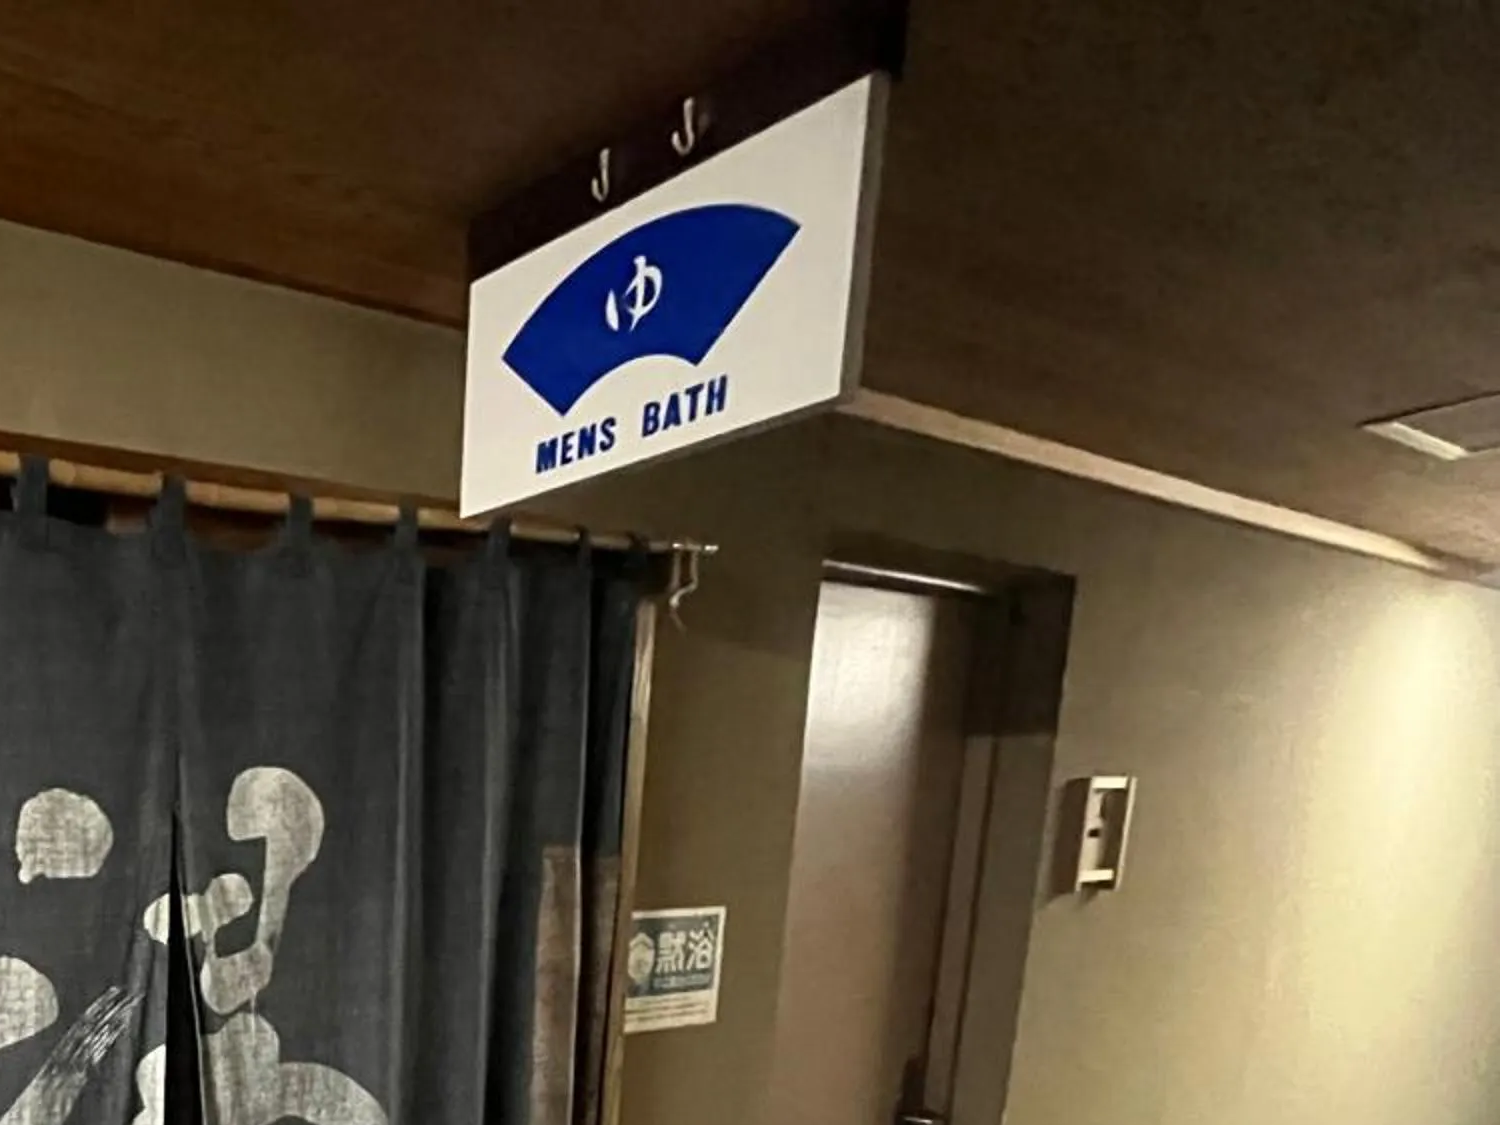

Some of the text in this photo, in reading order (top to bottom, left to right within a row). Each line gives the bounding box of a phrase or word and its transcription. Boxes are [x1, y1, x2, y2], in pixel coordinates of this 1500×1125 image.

[605, 254, 663, 332] ゆ
[535, 374, 728, 474] MENS BATH
